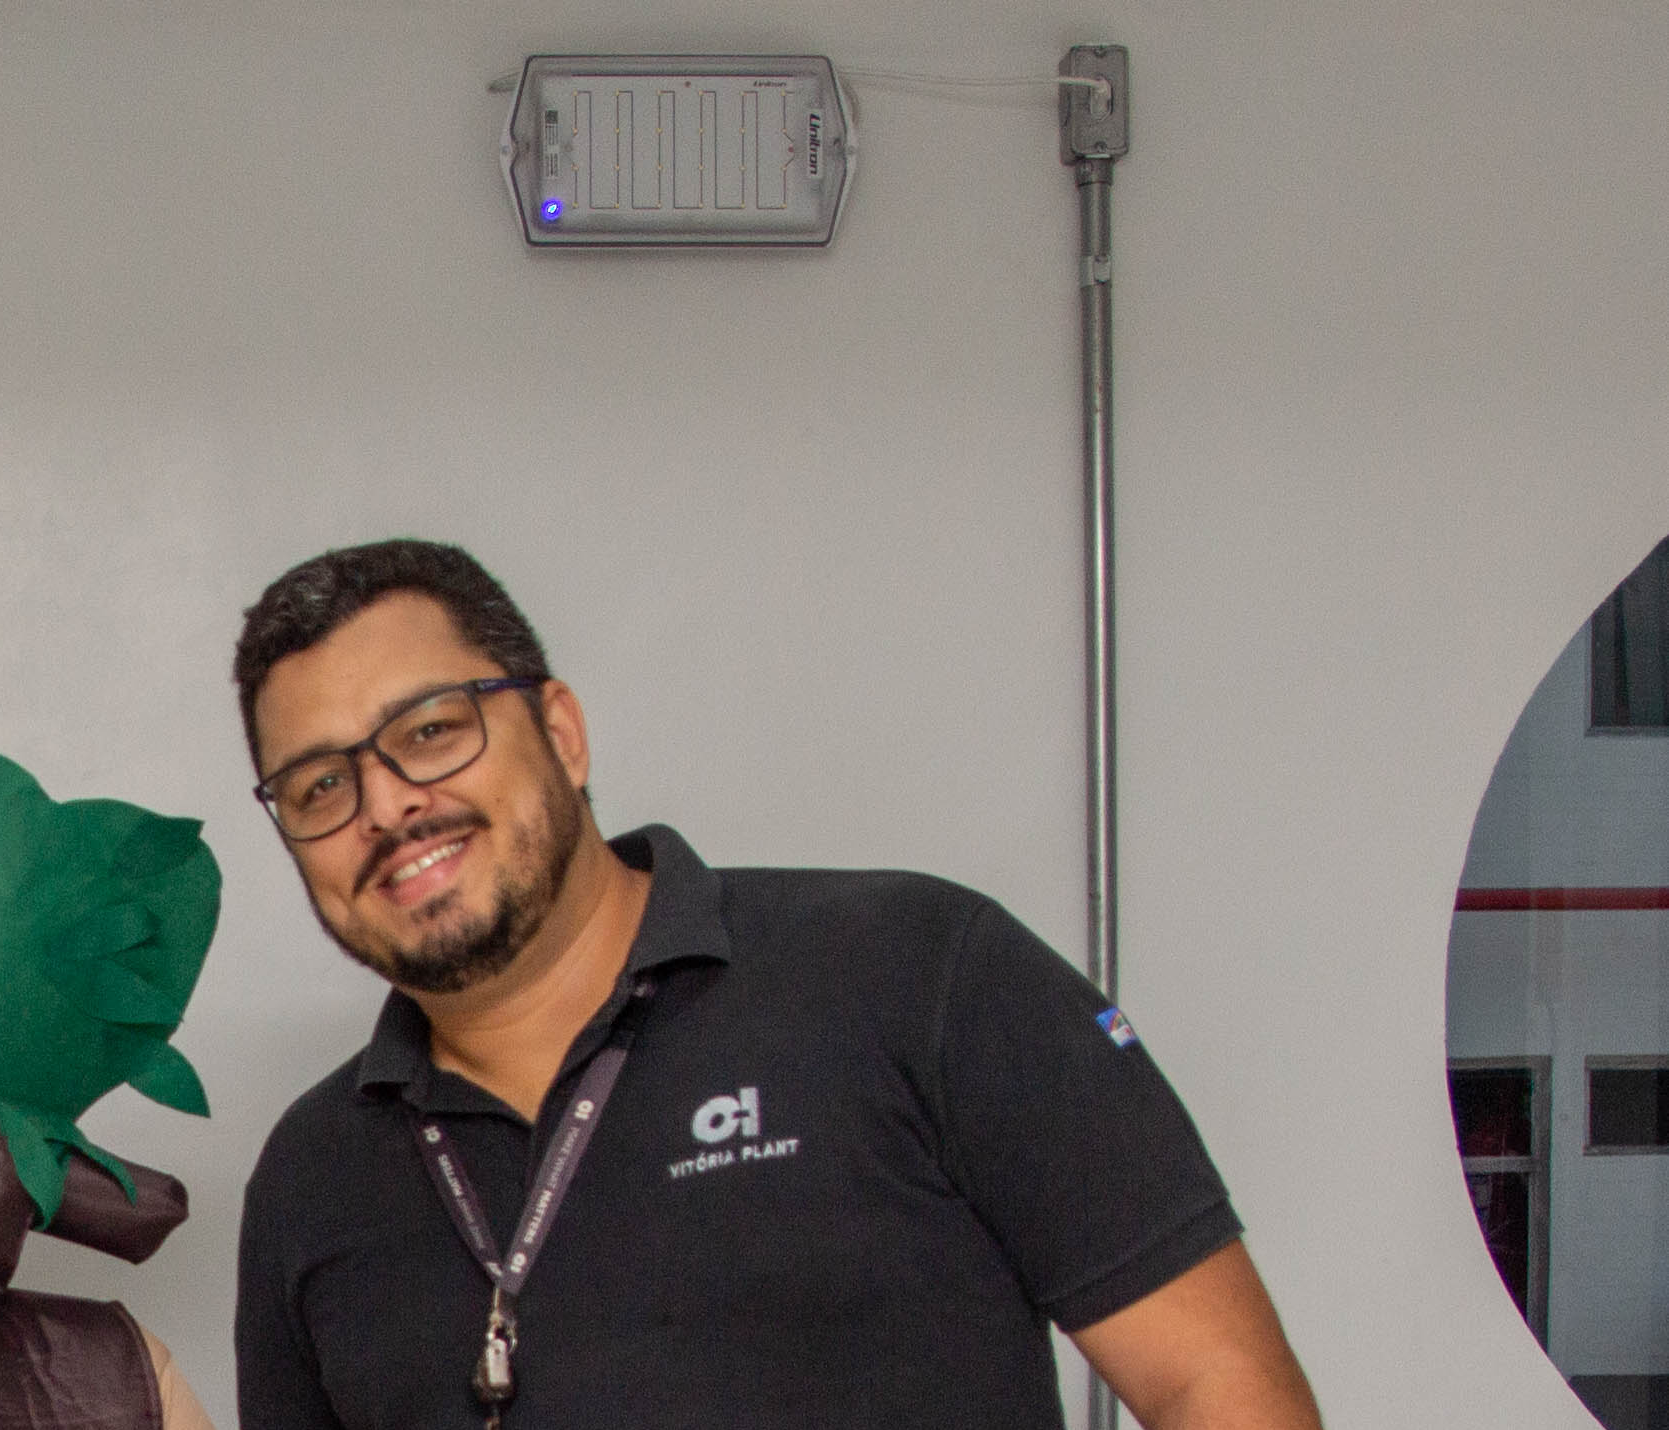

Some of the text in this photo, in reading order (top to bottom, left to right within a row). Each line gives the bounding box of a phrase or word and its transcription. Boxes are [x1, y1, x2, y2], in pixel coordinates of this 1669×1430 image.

[810, 113, 821, 174] Unitron
[437, 1154, 464, 1197] MATTERS
[667, 1138, 801, 1180] VITÓRIA PLANT
[523, 1190, 553, 1244] MATTERS
